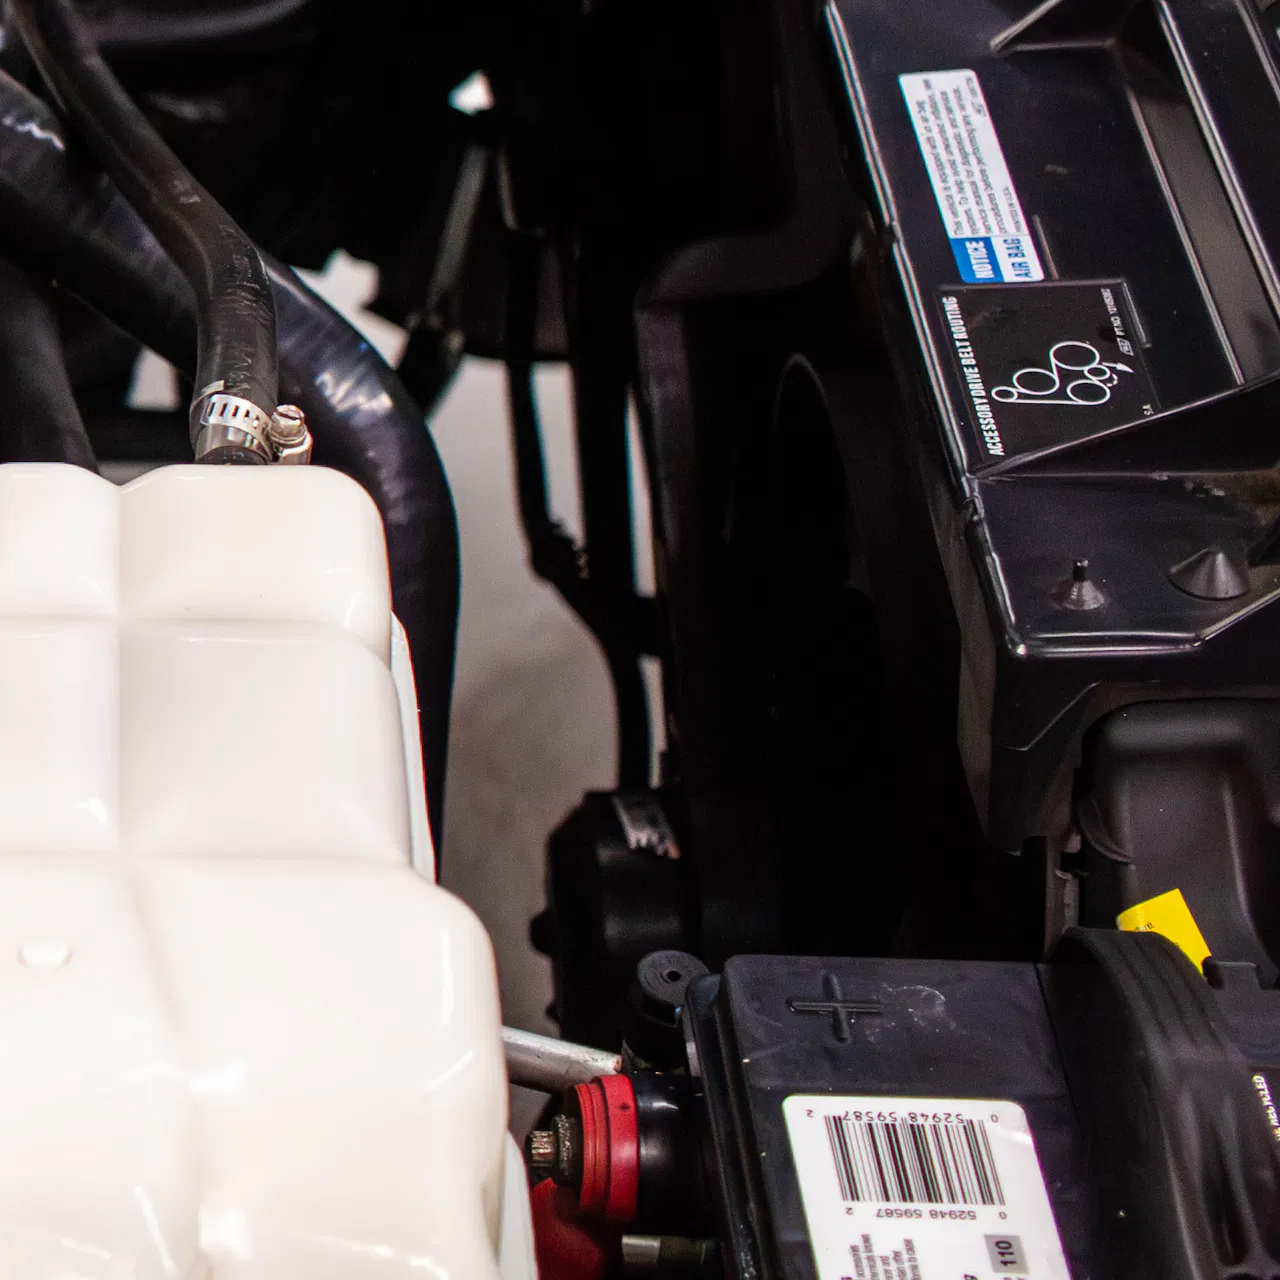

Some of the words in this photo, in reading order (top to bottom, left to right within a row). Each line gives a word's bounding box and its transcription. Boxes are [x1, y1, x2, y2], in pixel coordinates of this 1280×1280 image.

[1003, 238, 1025, 257] BAG
[965, 241, 993, 278] NOTICE
[1011, 261, 1030, 277] AIR
[942, 296, 967, 339] ROUTING
[955, 340, 975, 365] BELT
[963, 367, 985, 396] DRIVE
[973, 397, 1003, 455] ACCESSORY
[805, 1108, 815, 1119] 2
[842, 1109, 898, 1124] 59587
[906, 1110, 965, 1126] 52948
[990, 1113, 999, 1125] 0
[845, 1206, 854, 1217] 2
[875, 1206, 924, 1220] 59587
[928, 1208, 977, 1221] 52948
[998, 1211, 1008, 1221] 0
[995, 1240, 1017, 1267] 110
